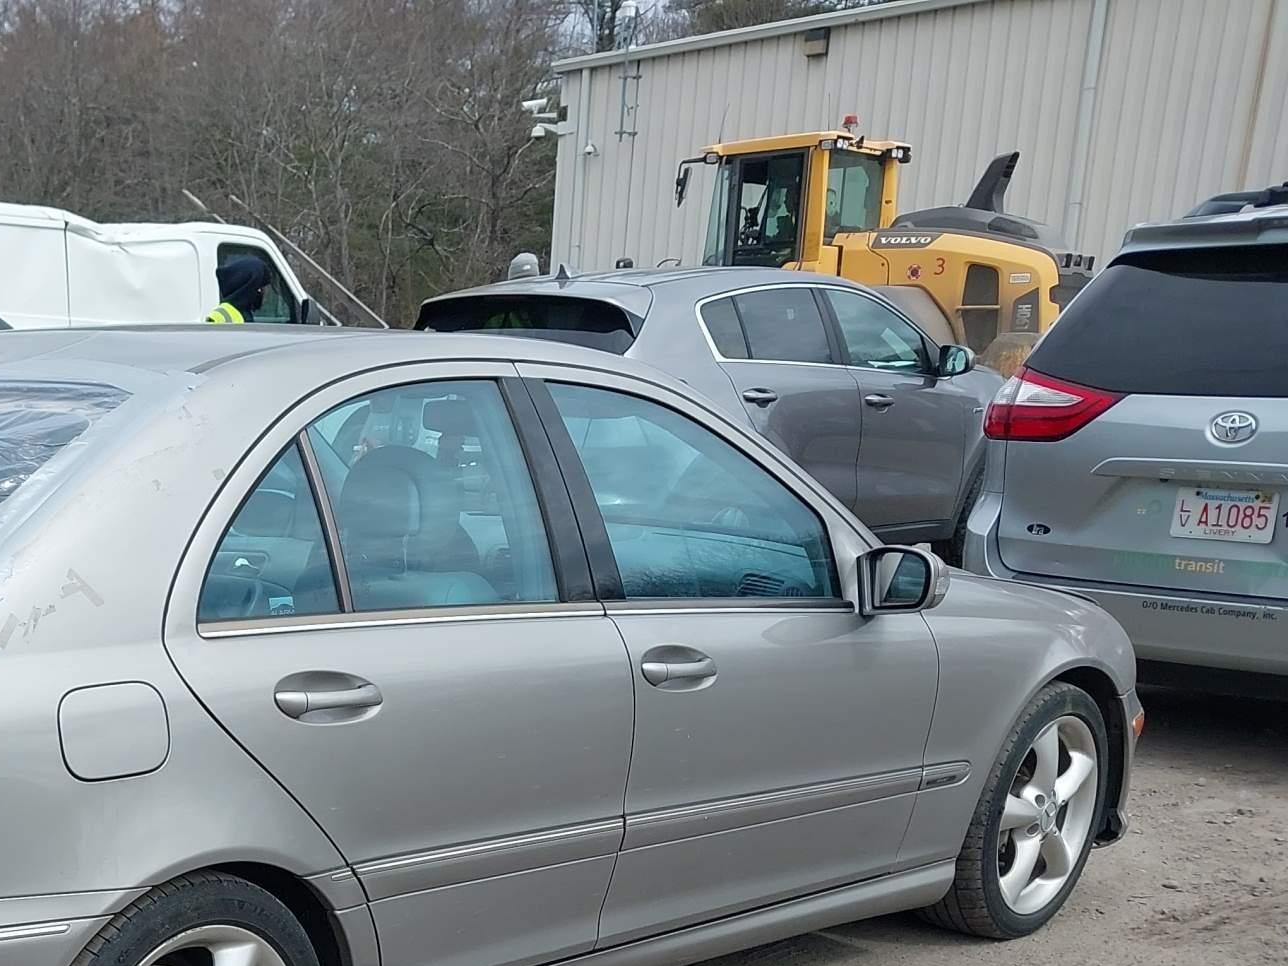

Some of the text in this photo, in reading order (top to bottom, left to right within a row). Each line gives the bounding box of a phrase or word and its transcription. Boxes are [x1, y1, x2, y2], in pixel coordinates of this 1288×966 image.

[880, 236, 932, 244] VOLVO
[934, 257, 946, 275] 3
[1200, 491, 1256, 503] Massachusetts
[1197, 502, 1271, 531] A1085
[1203, 528, 1237, 537] LIVERY
[1175, 558, 1225, 574] transit
[1160, 602, 1198, 613] Mercedes
[1200, 605, 1216, 615] Cab
